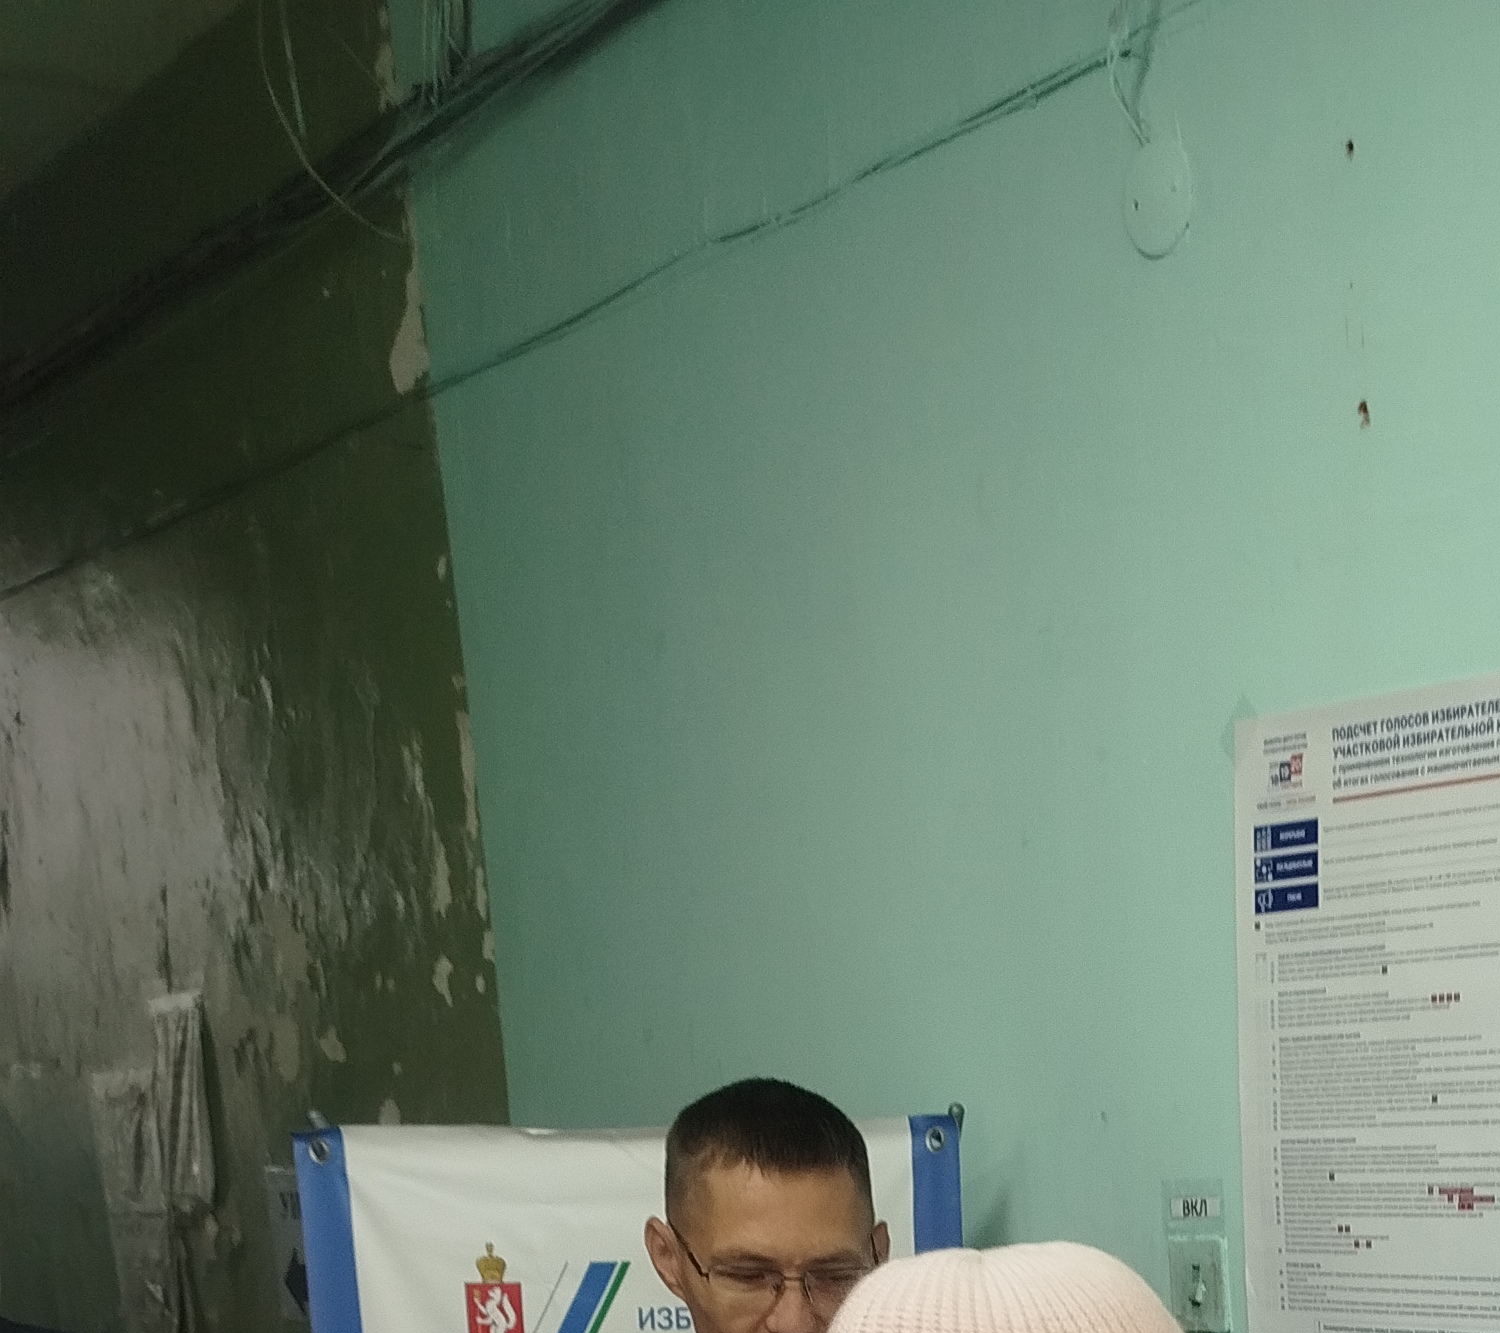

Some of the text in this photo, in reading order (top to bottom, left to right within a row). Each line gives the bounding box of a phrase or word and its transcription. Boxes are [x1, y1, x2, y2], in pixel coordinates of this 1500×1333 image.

[1331, 720, 1379, 742] ПОДСЧЕТ
[1380, 712, 1430, 733] ГОЛОСОВ
[1332, 734, 1401, 759] УЧАСТКОВОЙ
[1402, 718, 1495, 748] ИЗБИРАТЕЛЬНОЙ
[1182, 1199, 1208, 1217] ВКЛ
